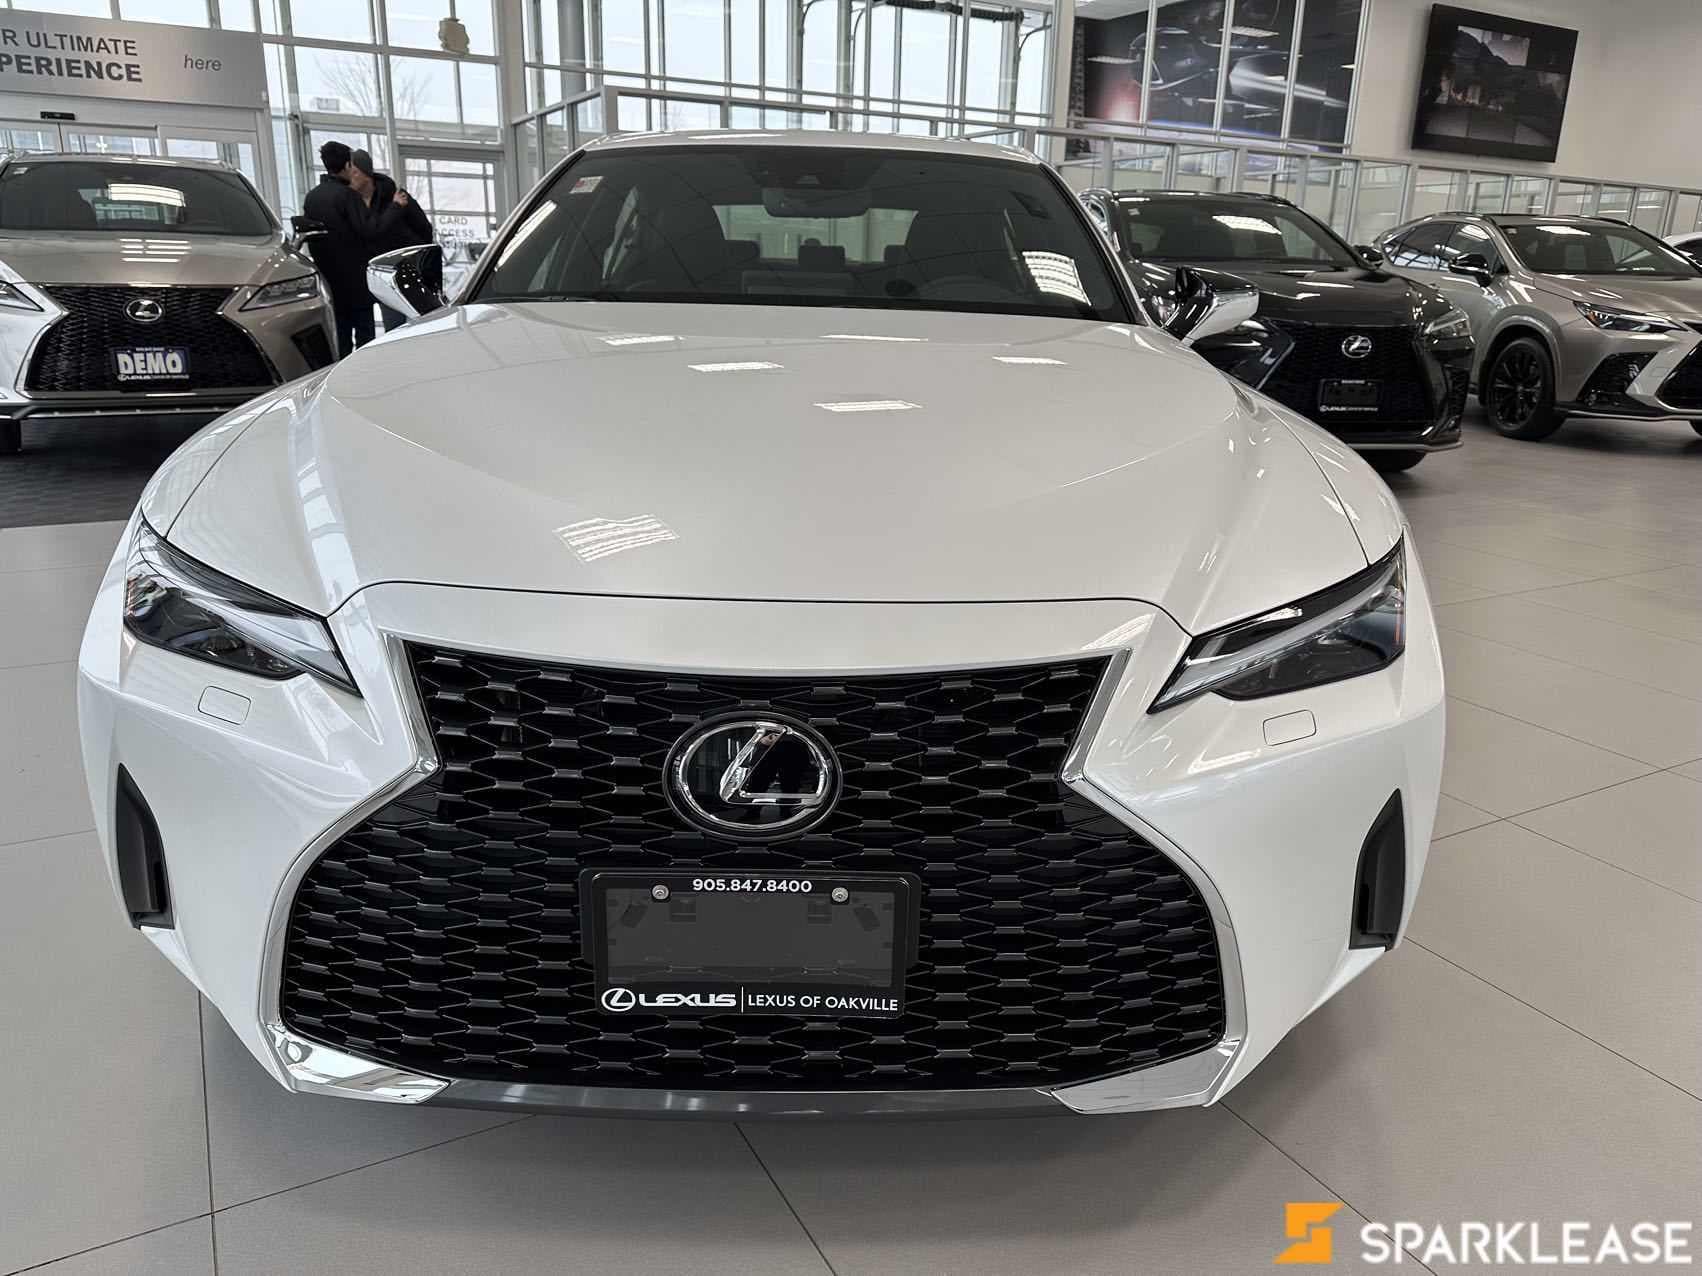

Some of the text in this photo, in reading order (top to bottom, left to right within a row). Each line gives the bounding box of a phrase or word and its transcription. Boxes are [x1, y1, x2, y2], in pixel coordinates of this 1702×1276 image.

[25, 31, 138, 56] ULTIMATE
[0, 53, 143, 82] PERIENCE
[183, 54, 222, 71] here
[116, 352, 183, 375] DEMO
[692, 878, 813, 893] 905.847.8400
[638, 994, 898, 1011] LEXUS LEXUS OF OAKVILLE
